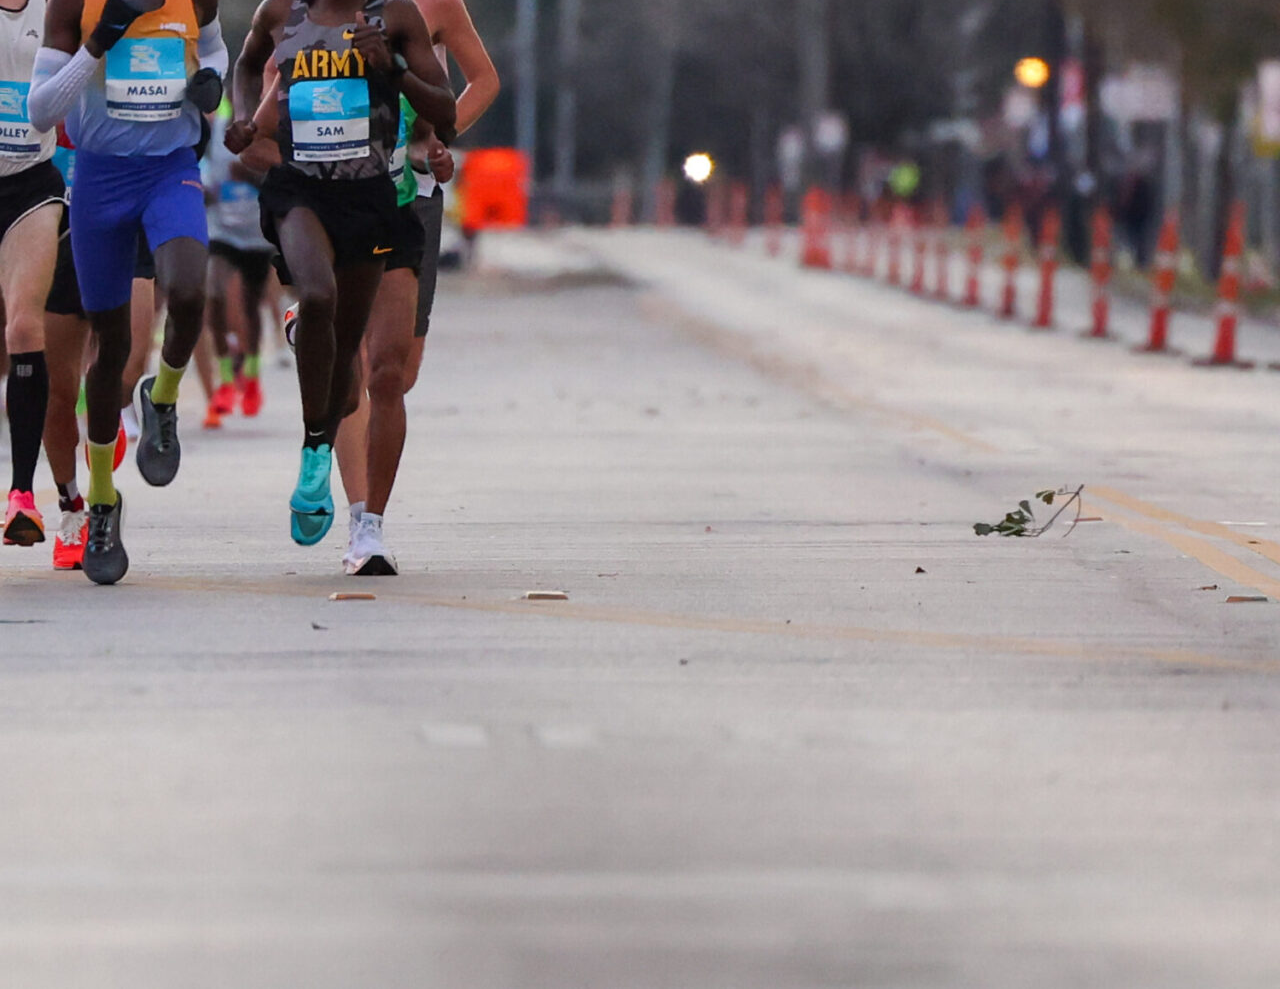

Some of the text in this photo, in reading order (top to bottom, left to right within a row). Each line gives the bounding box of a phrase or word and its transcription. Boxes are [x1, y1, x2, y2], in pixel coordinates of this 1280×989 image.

[291, 48, 365, 79] ARMY
[127, 86, 167, 96] MASAI
[316, 126, 345, 137] SAM
